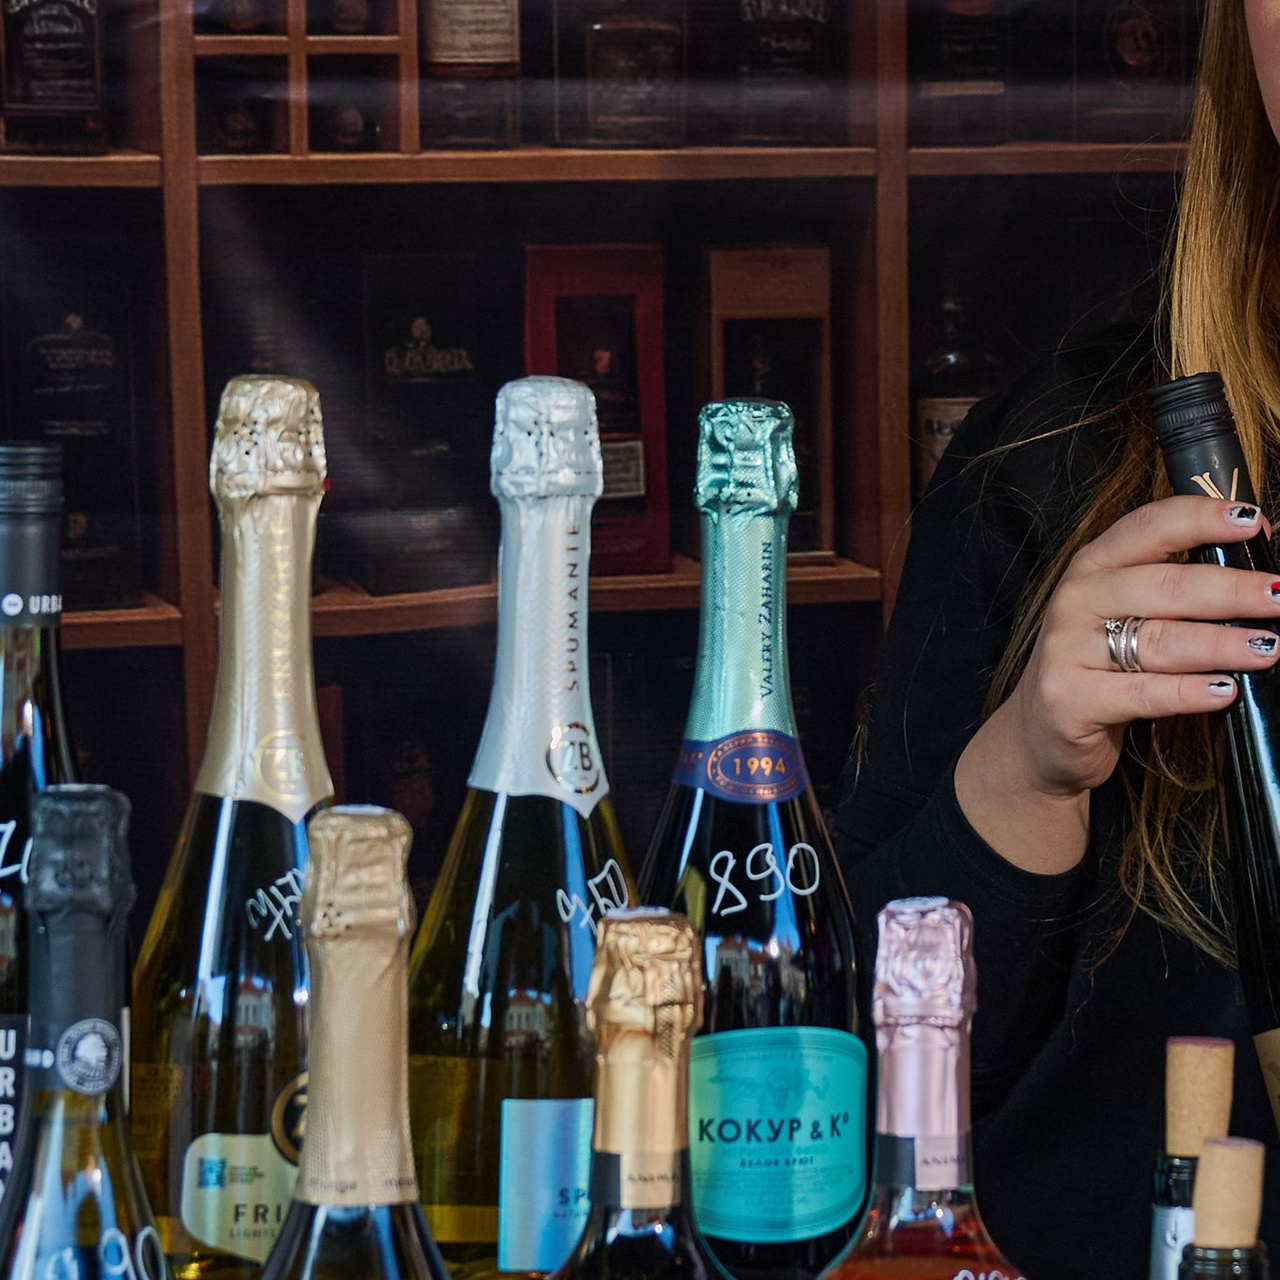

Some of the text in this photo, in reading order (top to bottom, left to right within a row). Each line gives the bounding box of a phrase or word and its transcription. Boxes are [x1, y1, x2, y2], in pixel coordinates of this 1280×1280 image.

[567, 523, 580, 692] SPUMANTE
[758, 541, 773, 626] ZAHARIN
[733, 756, 786, 777] 1994
[709, 842, 821, 917] 890
[698, 1118, 802, 1143] КОКУР
[810, 1121, 824, 1140] &
